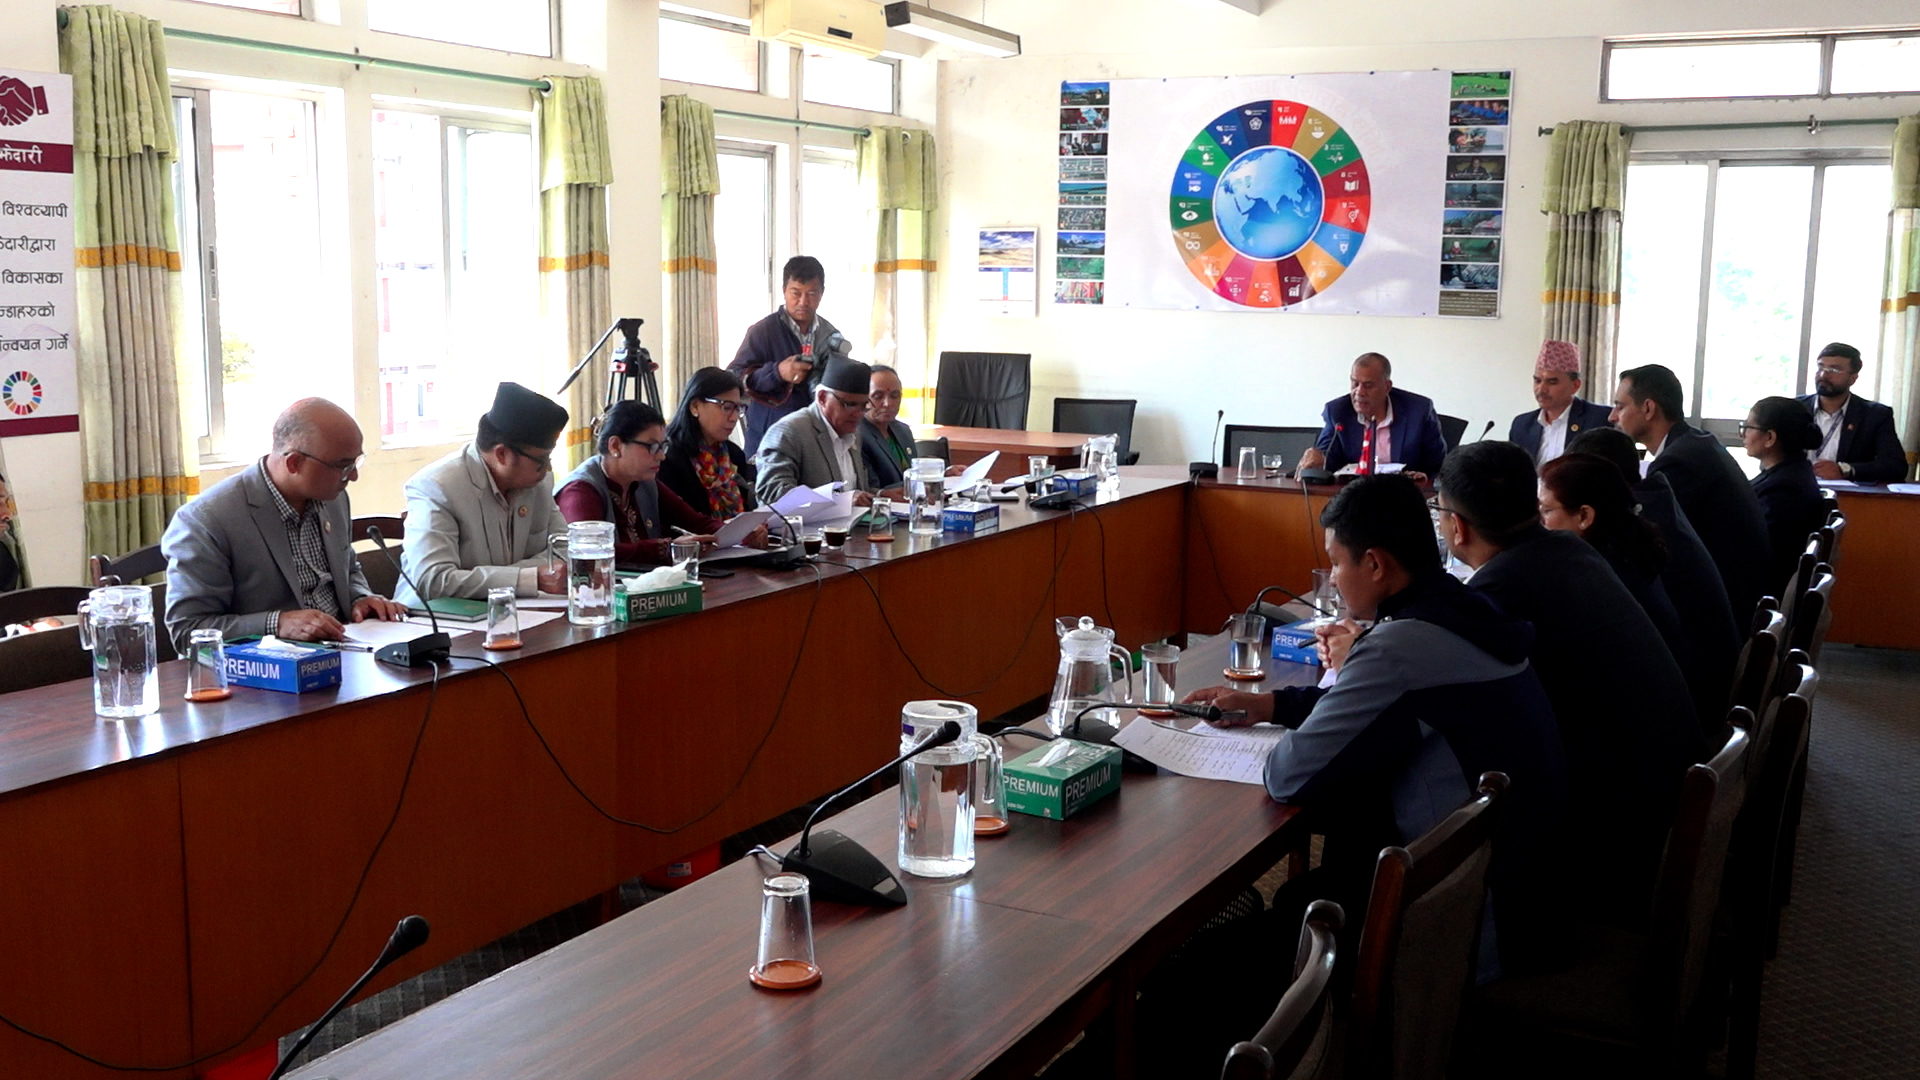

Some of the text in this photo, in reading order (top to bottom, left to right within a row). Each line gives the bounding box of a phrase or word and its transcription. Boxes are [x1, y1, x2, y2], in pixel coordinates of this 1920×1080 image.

[2, 200, 68, 217] विश्वव्यापी
[2, 269, 63, 284] विकासका
[46, 333, 69, 350] गर्ने
[630, 592, 688, 612] PREMIUM
[223, 658, 280, 680] PREMIUM
[301, 657, 340, 676] PREMIUM
[1003, 775, 1059, 798] PREMIUM
[1065, 764, 1111, 804] PREMIUM
